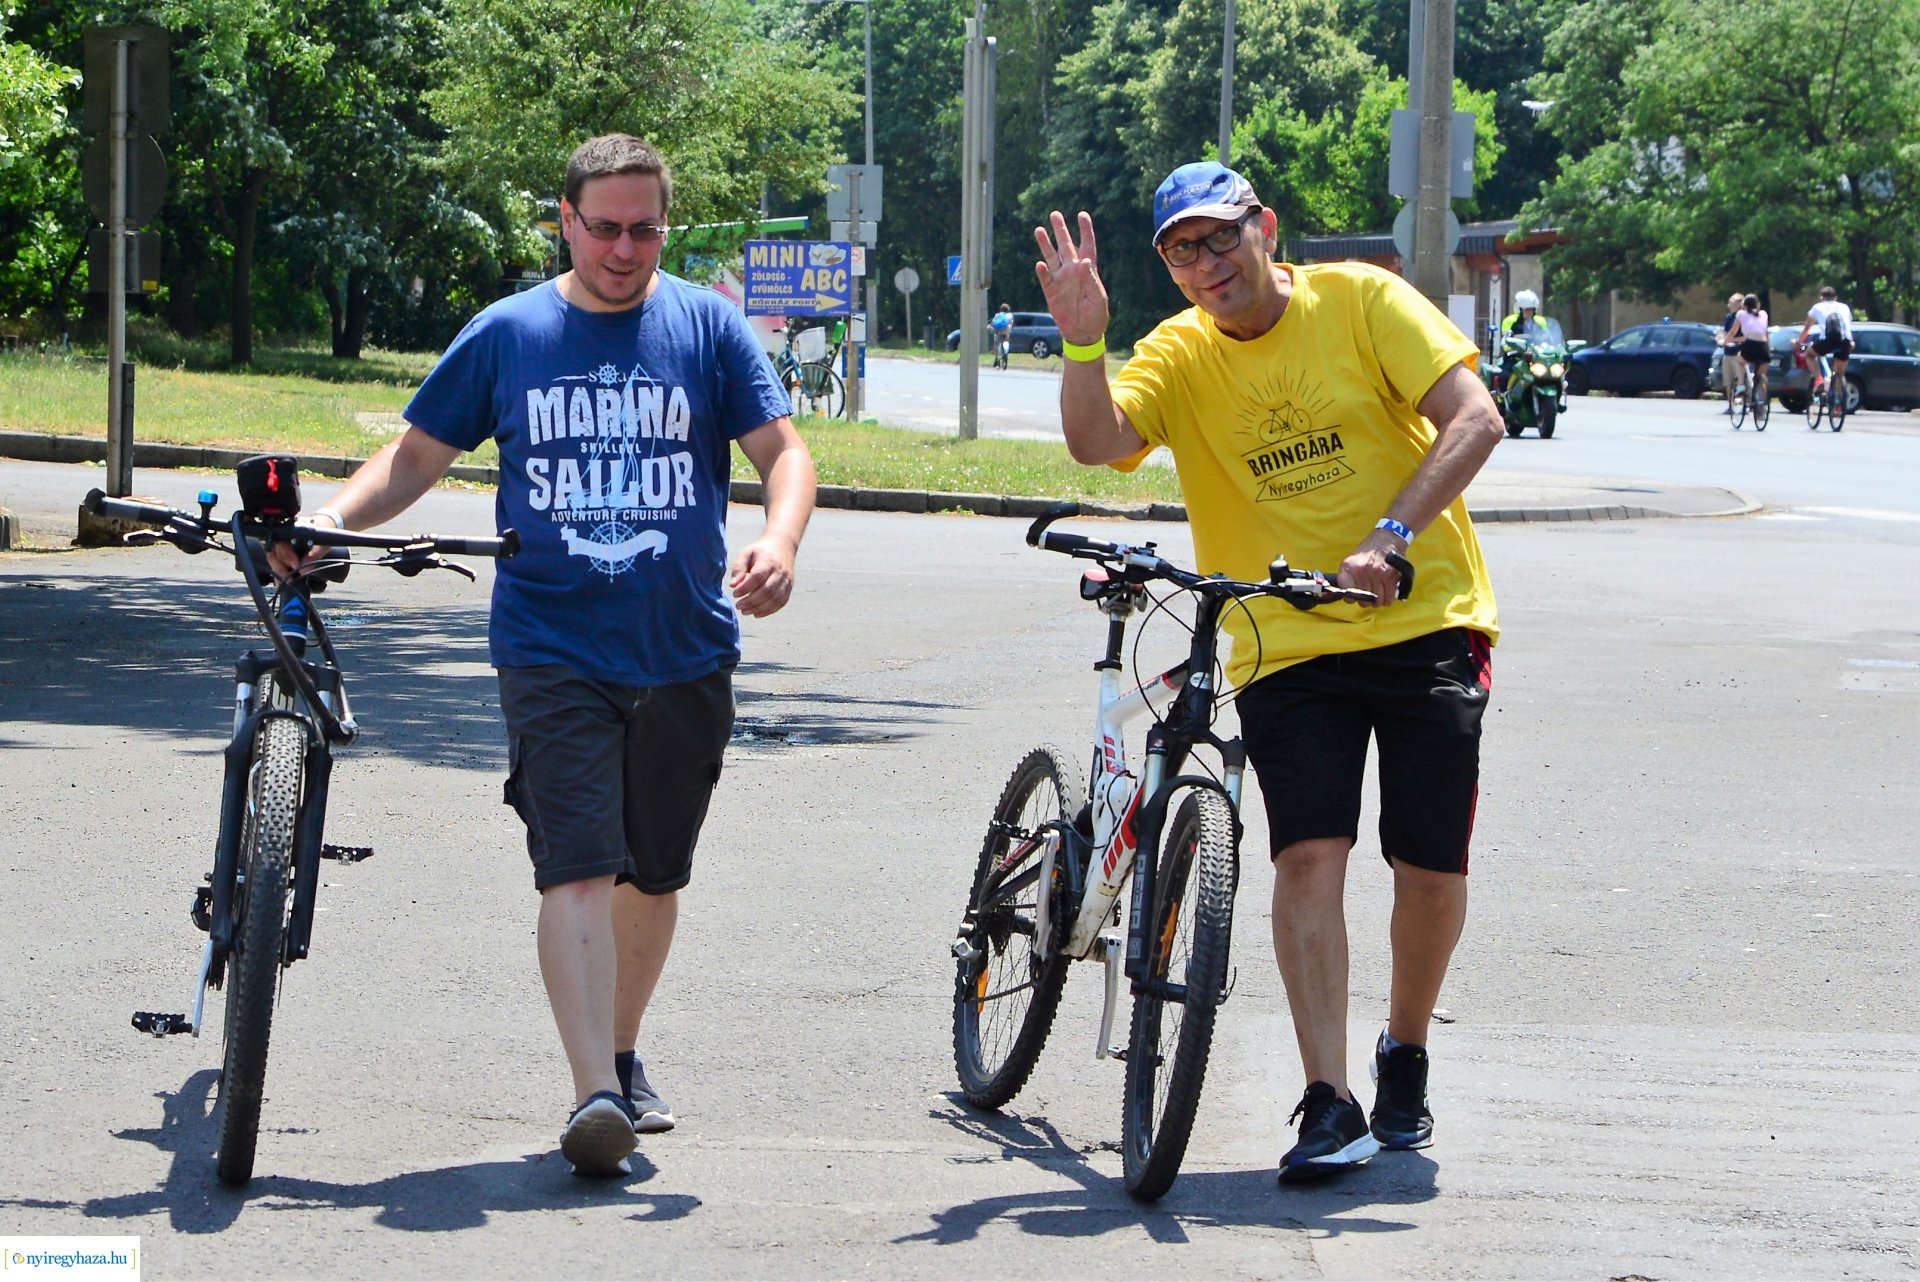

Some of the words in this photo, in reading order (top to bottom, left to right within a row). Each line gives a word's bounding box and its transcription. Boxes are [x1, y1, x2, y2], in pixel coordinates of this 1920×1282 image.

[750, 244, 804, 268] MINI
[800, 268, 848, 293] ABC
[526, 385, 691, 446] MARINA
[1247, 432, 1344, 478] BRINGÁRA
[525, 450, 697, 511] SAILOR
[1268, 466, 1341, 497] Nyíregyháza
[551, 509, 617, 522] ADVENTURE
[622, 509, 678, 521] CRUISING
